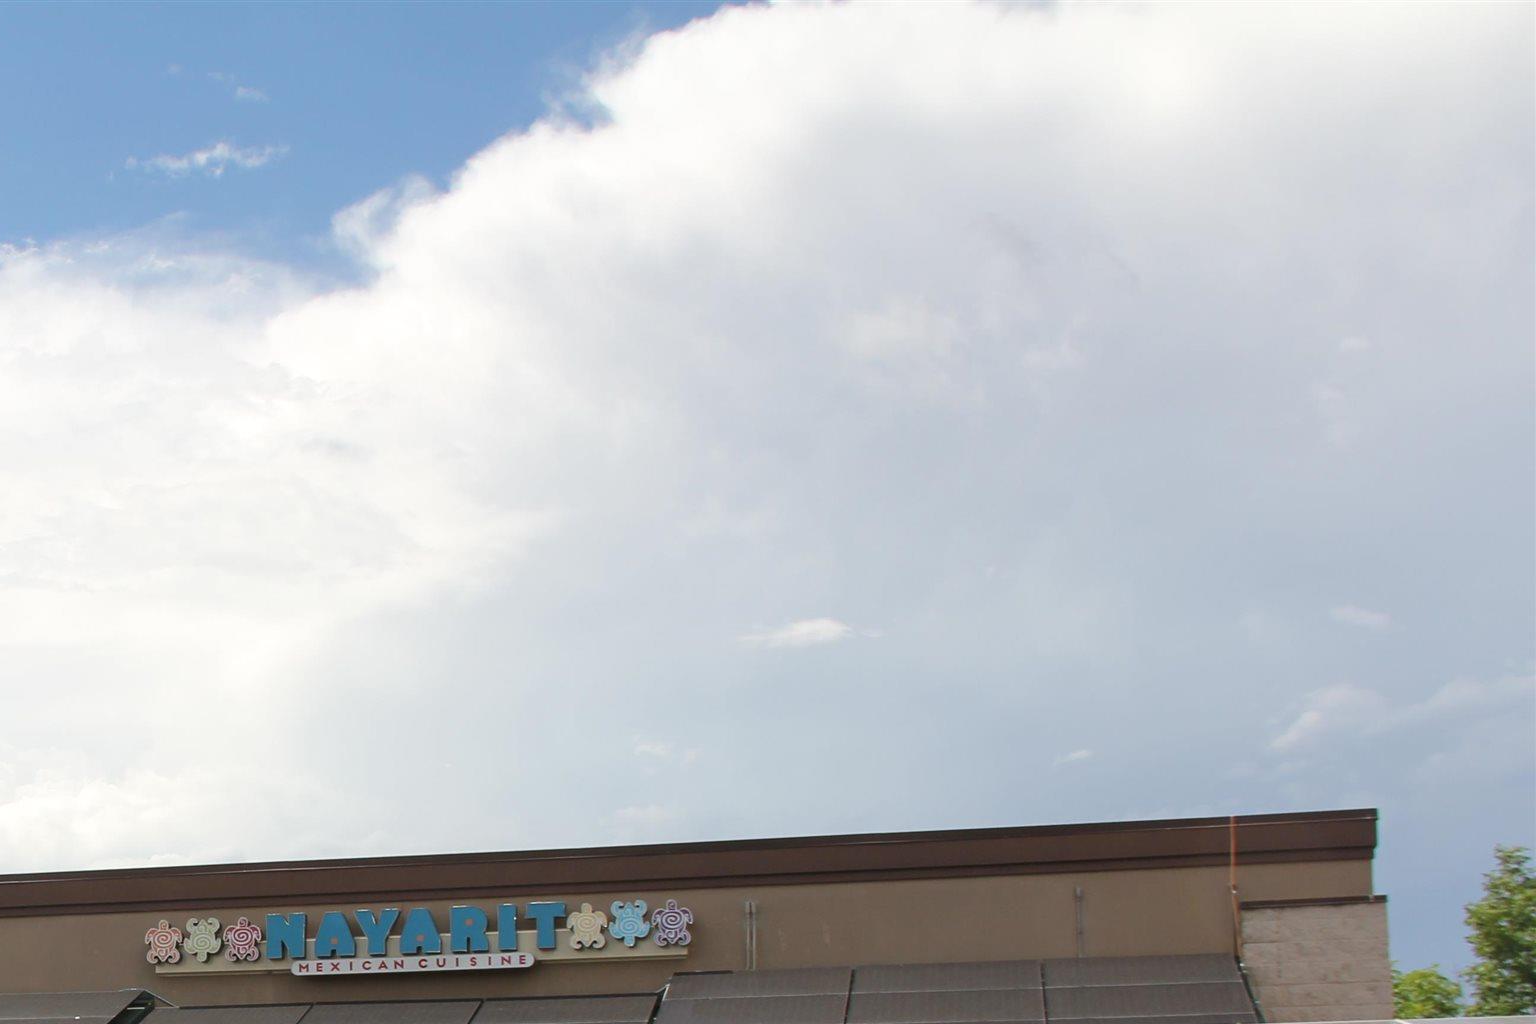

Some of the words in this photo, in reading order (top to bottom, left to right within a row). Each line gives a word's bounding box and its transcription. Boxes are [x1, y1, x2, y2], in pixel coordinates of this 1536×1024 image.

[265, 901, 567, 959] NAYARIT
[297, 958, 405, 974] MEXICAN
[417, 953, 528, 970] CUISINE
